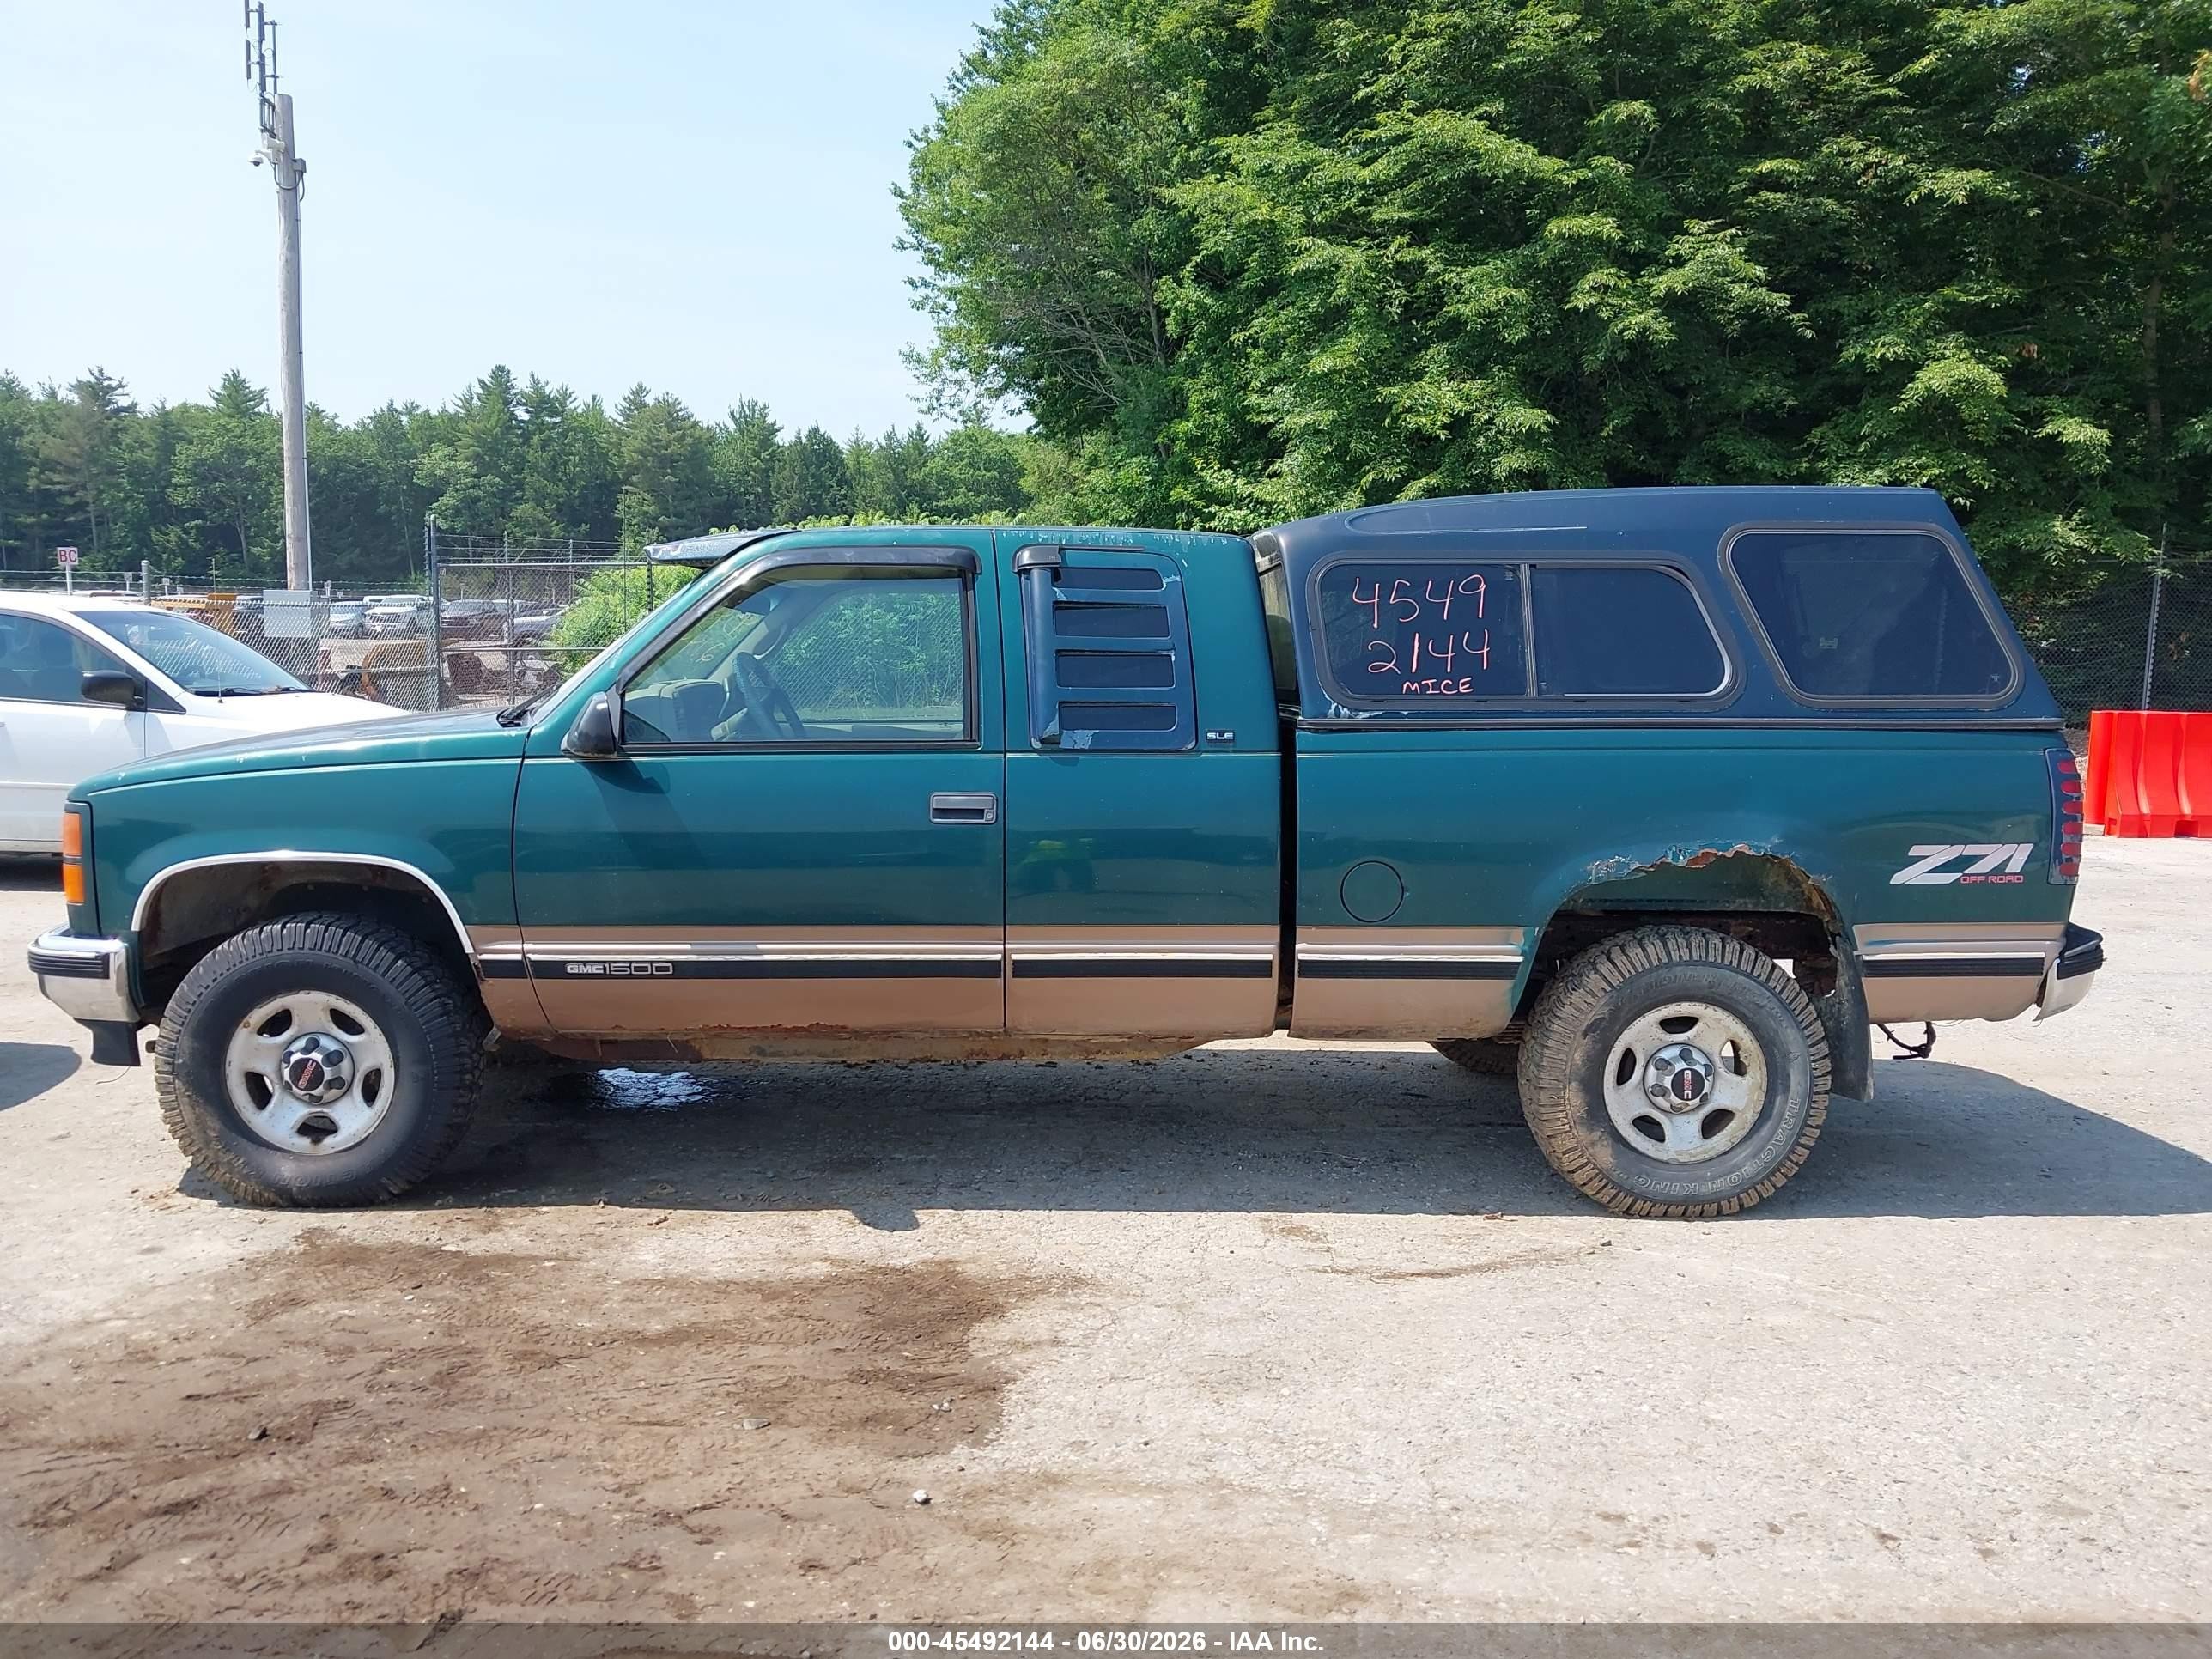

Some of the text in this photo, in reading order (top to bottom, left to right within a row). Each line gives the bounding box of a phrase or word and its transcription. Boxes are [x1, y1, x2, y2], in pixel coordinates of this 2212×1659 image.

[58, 549, 77, 562] BC
[1352, 574, 1487, 629] 4549
[1368, 629, 1490, 674] 2144
[1402, 677, 1474, 695] MICE
[1889, 843, 2034, 884] Z71
[1960, 875, 2024, 884] OFF ROAD
[1634, 1098, 1801, 1194] TRACTION KING
